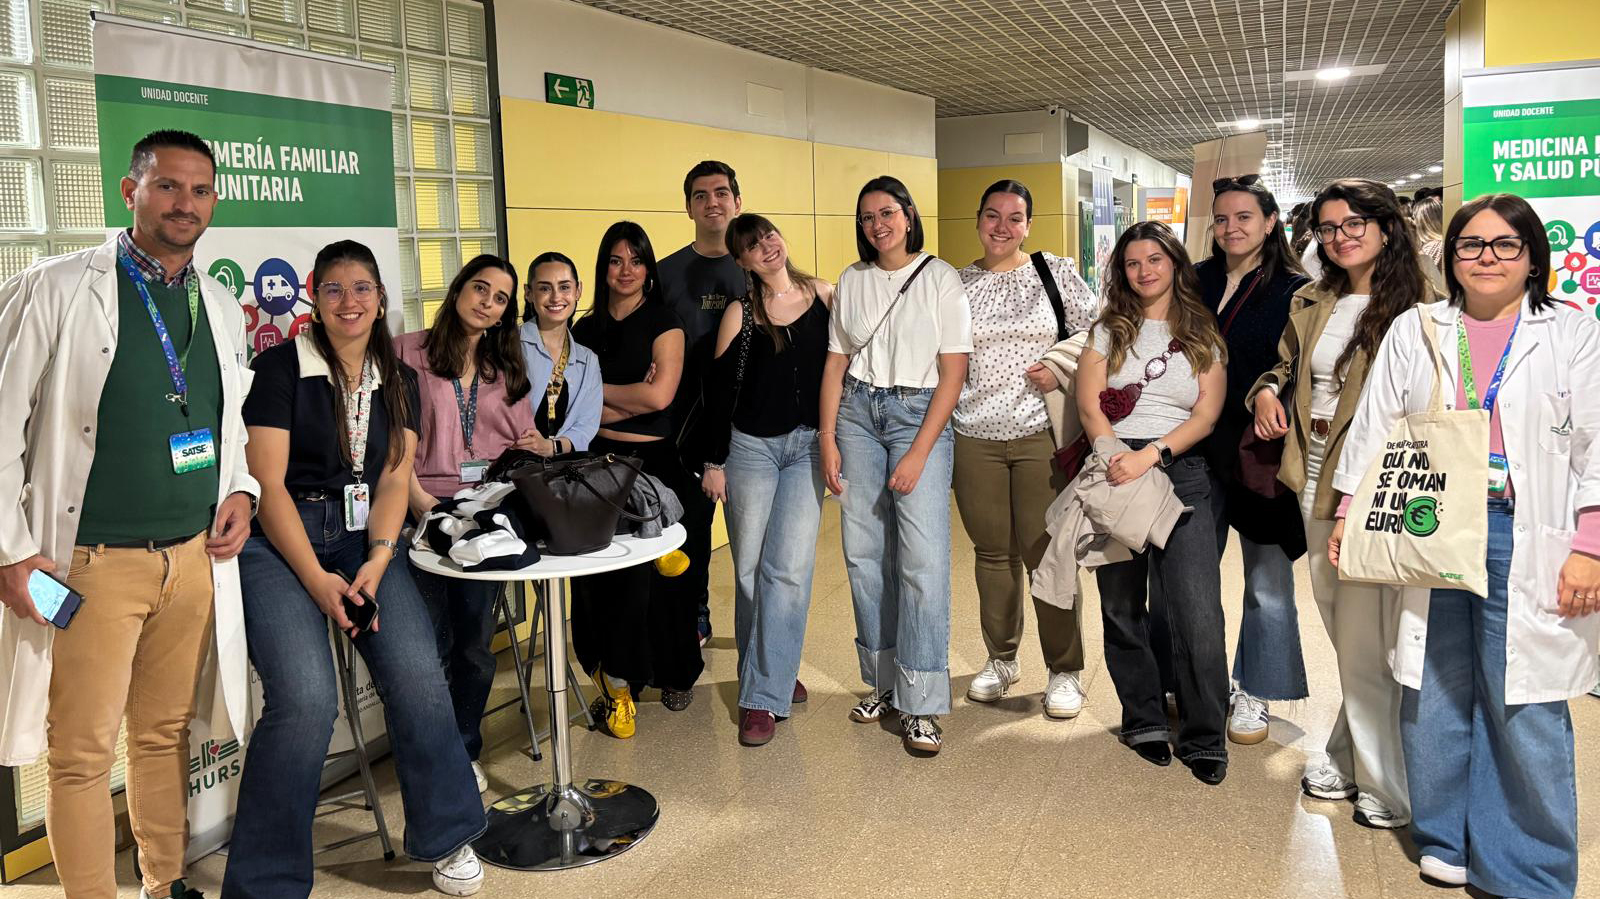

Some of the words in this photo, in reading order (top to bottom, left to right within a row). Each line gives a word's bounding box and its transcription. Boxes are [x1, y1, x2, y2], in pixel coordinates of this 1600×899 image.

[141, 87, 171, 101] UNIDAD
[173, 90, 208, 105] DOCENTE
[1493, 109, 1520, 118] UNIDAD
[1521, 106, 1554, 116] DOCENTE
[1493, 136, 1589, 160] MEDICINA
[280, 146, 359, 175] FAMILIAR
[1492, 163, 1506, 183] Y
[1510, 159, 1574, 181] SALUD
[182, 444, 207, 457] SATSE
[1407, 451, 1430, 470] NO
[1376, 471, 1395, 489] SE
[1371, 490, 1387, 508] NI
[1389, 491, 1408, 511] UN
[1364, 510, 1405, 534] EURO
[188, 758, 241, 797] HURS
